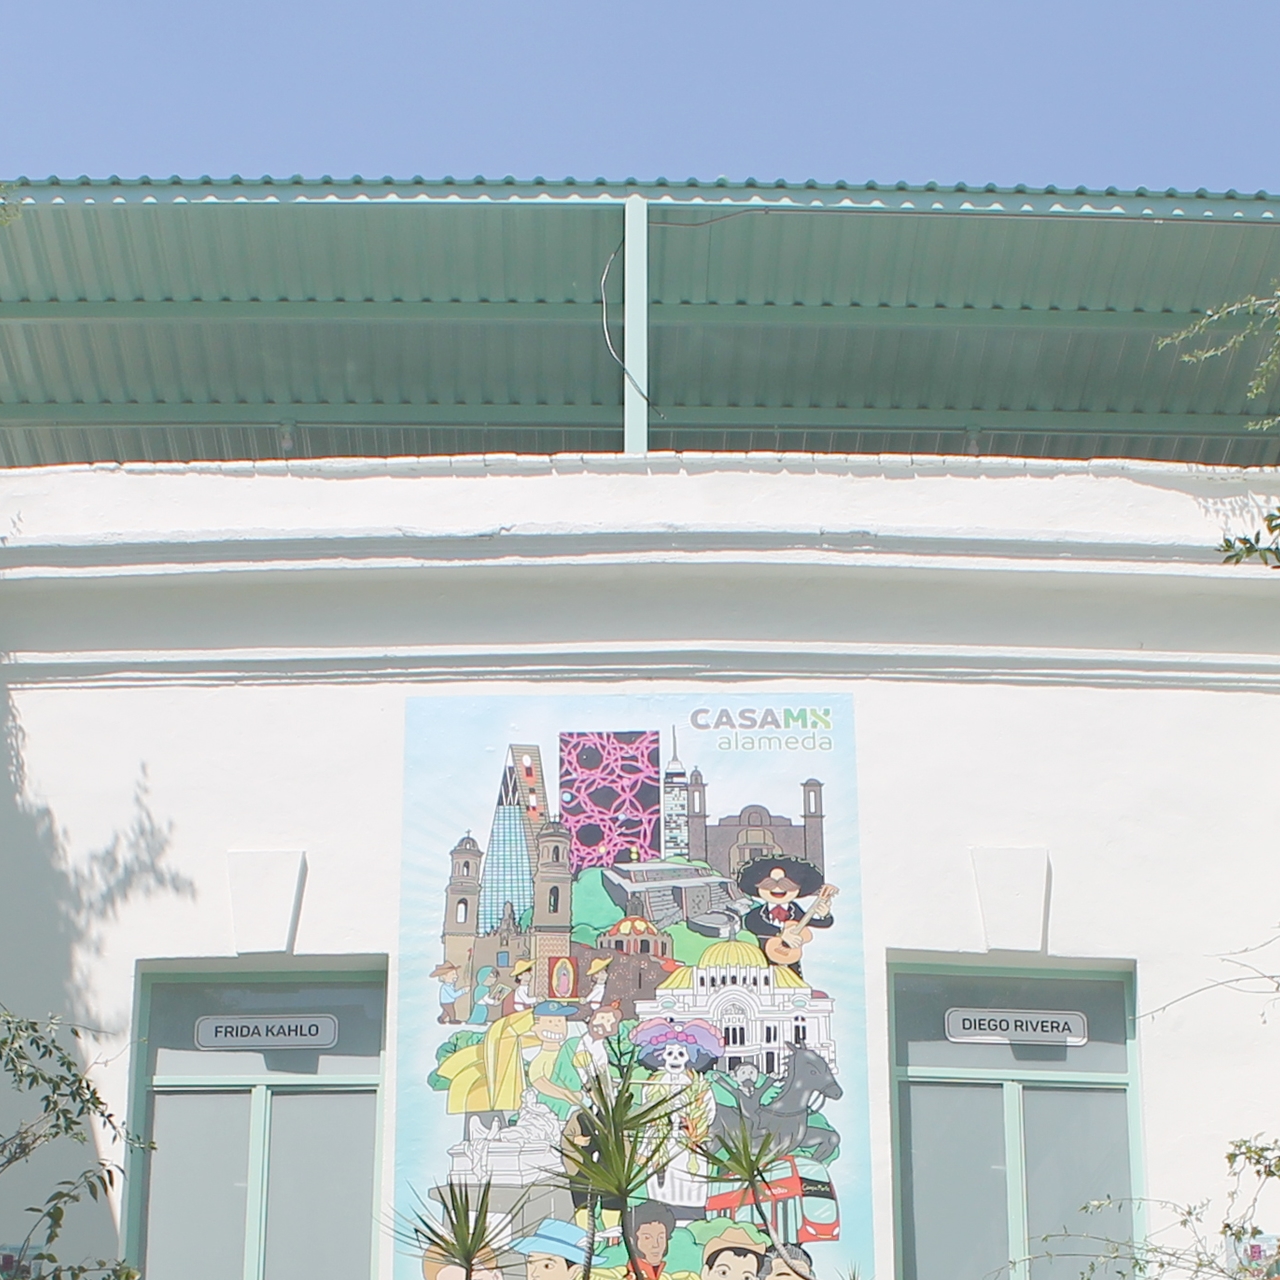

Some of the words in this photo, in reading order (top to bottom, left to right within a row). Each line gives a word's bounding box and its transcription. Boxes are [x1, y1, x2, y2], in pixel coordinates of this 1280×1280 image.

[690, 708, 831, 730] CASAMX
[718, 732, 832, 750] alameda
[214, 1025, 261, 1038] FRIDA
[265, 1024, 319, 1037] KAHLO
[962, 1018, 1009, 1031] DIEGO
[1014, 1020, 1072, 1033] RIVERA
